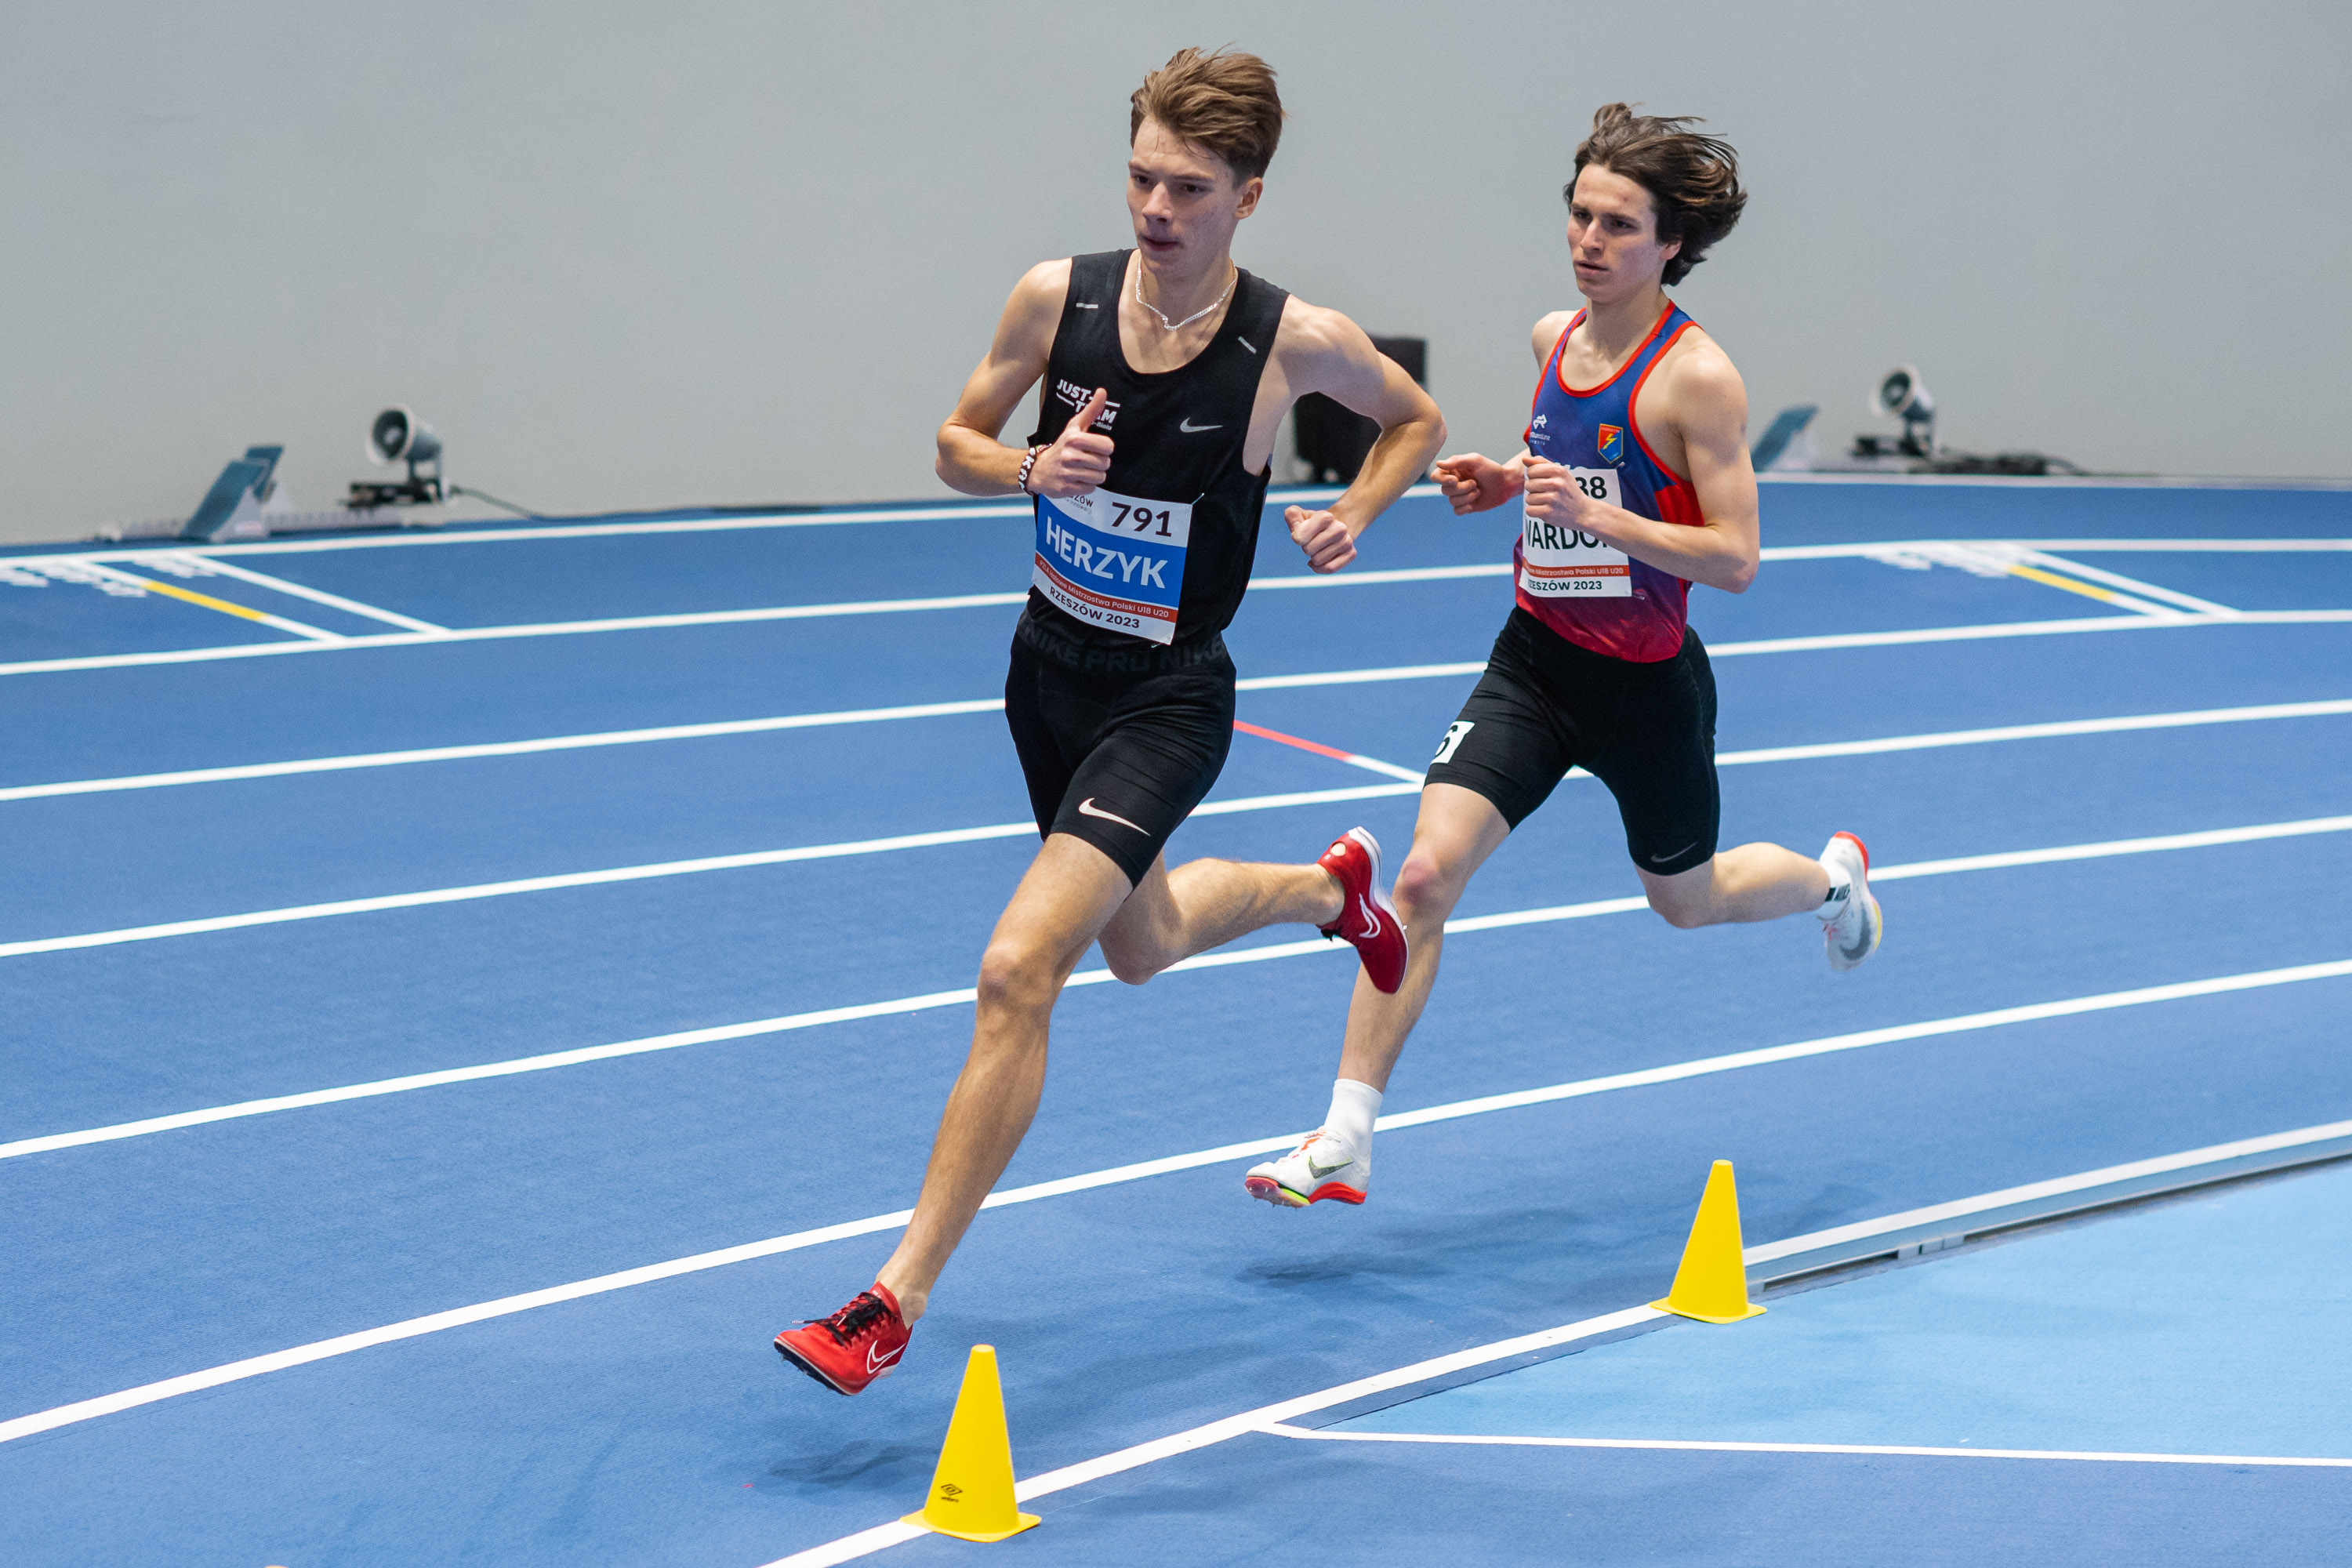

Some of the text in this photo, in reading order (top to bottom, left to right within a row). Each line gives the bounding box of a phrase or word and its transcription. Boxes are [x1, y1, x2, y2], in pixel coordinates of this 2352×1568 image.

[1057, 379, 1091, 401] JUST
[1076, 400, 1117, 423] TM
[1070, 495, 1094, 507] ZÓW
[1111, 502, 1172, 538] 791
[1526, 518, 1607, 550] ARDO
[1046, 515, 1168, 589] HERZYK
[1068, 584, 1110, 606] Mistrzostwa
[1112, 601, 1135, 612] Polski
[1137, 606, 1151, 615] U18
[1152, 608, 1169, 618] U20
[1573, 580, 1602, 590] 2023
[1050, 586, 1140, 629] RZESZÓW 2023
